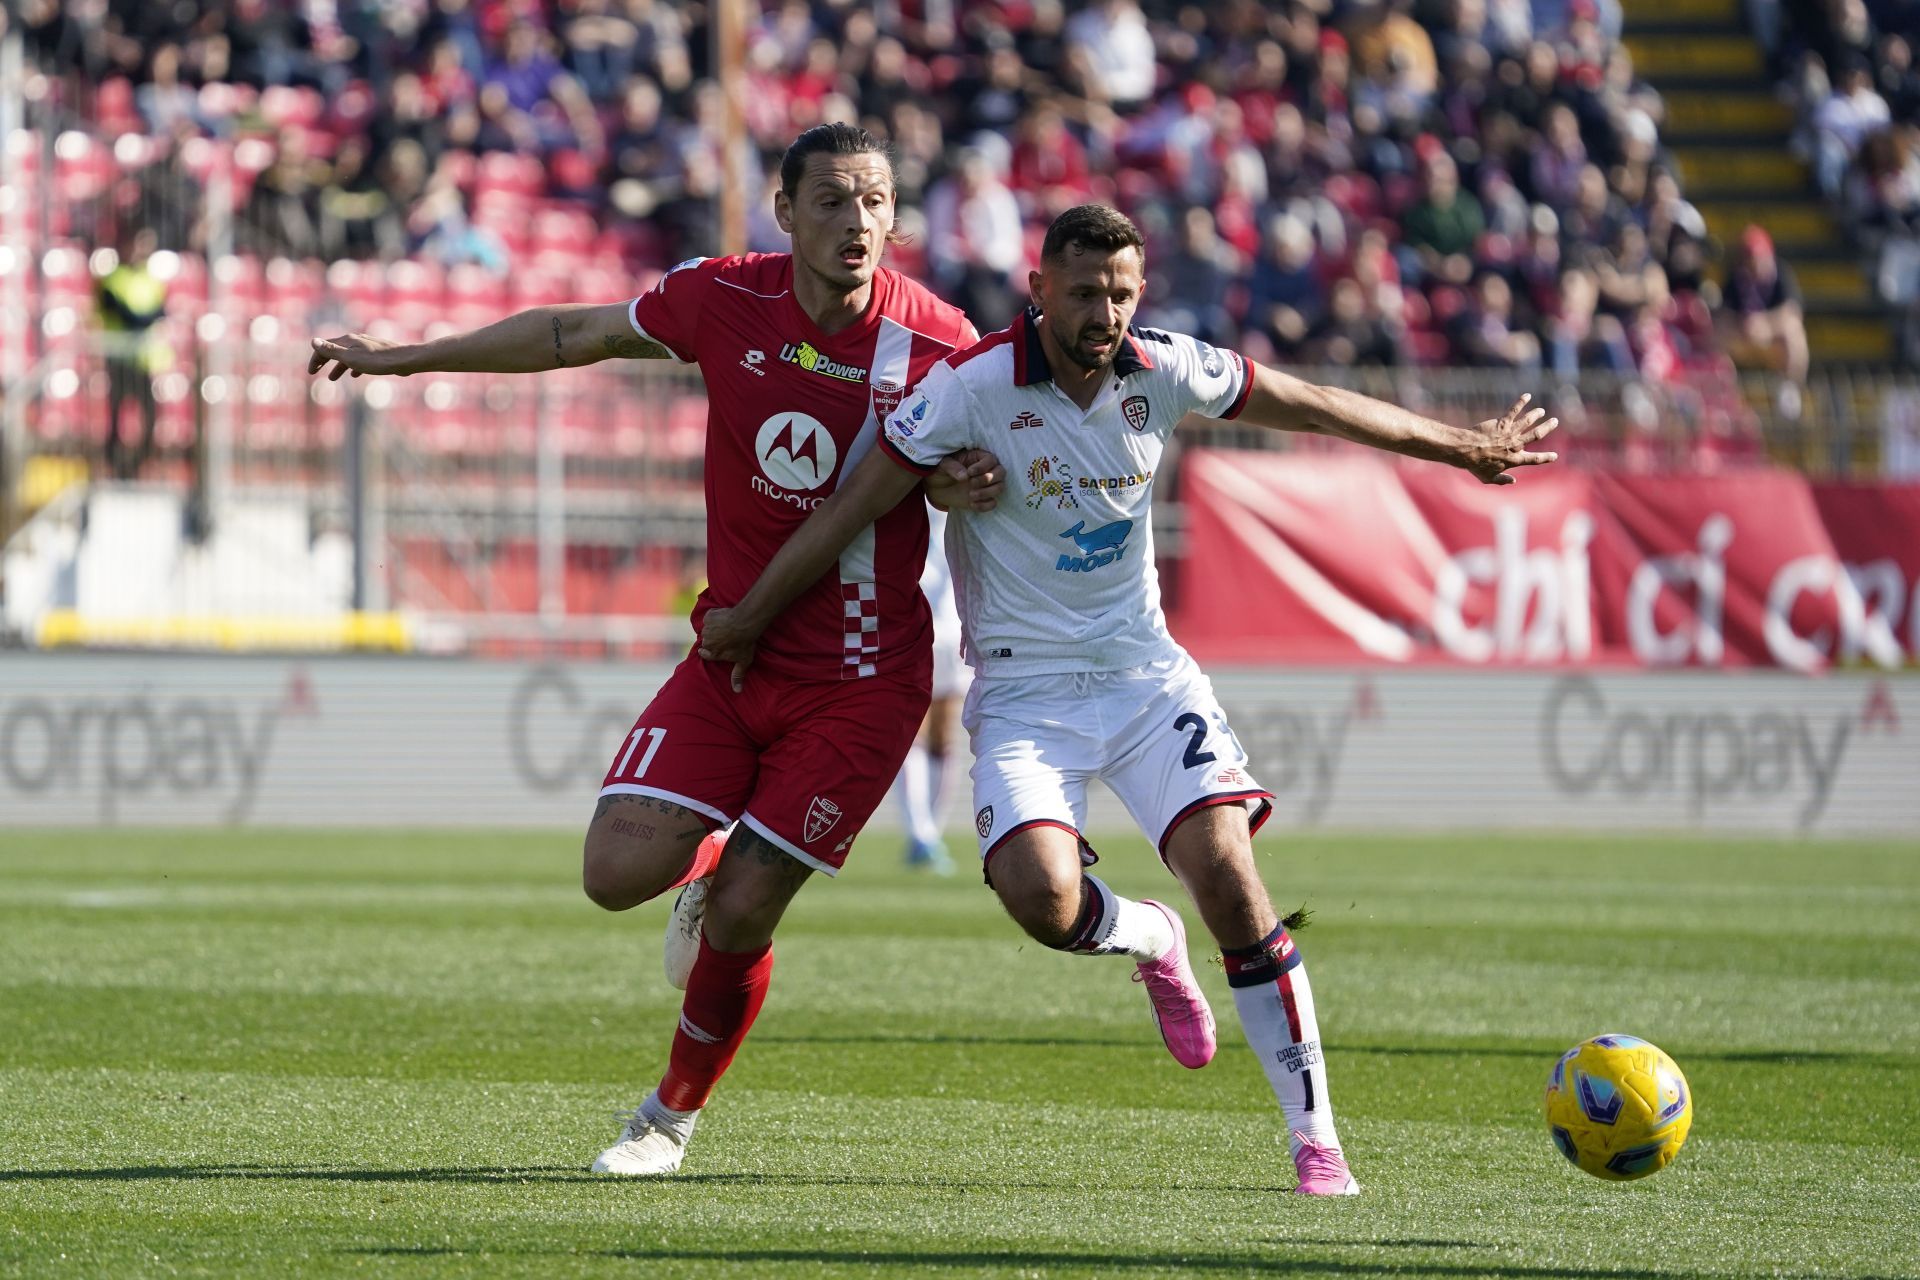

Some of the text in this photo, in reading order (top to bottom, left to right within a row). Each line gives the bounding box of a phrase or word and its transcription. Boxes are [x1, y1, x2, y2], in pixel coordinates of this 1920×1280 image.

[1079, 470, 1153, 489] SARDEGNA
[1056, 544, 1129, 573] MOBY
[1434, 504, 1591, 662] chi
[1627, 514, 1734, 664] ci
[614, 727, 667, 779] 11
[1539, 674, 1852, 828] Corpay
[811, 810, 832, 826] MONZA
